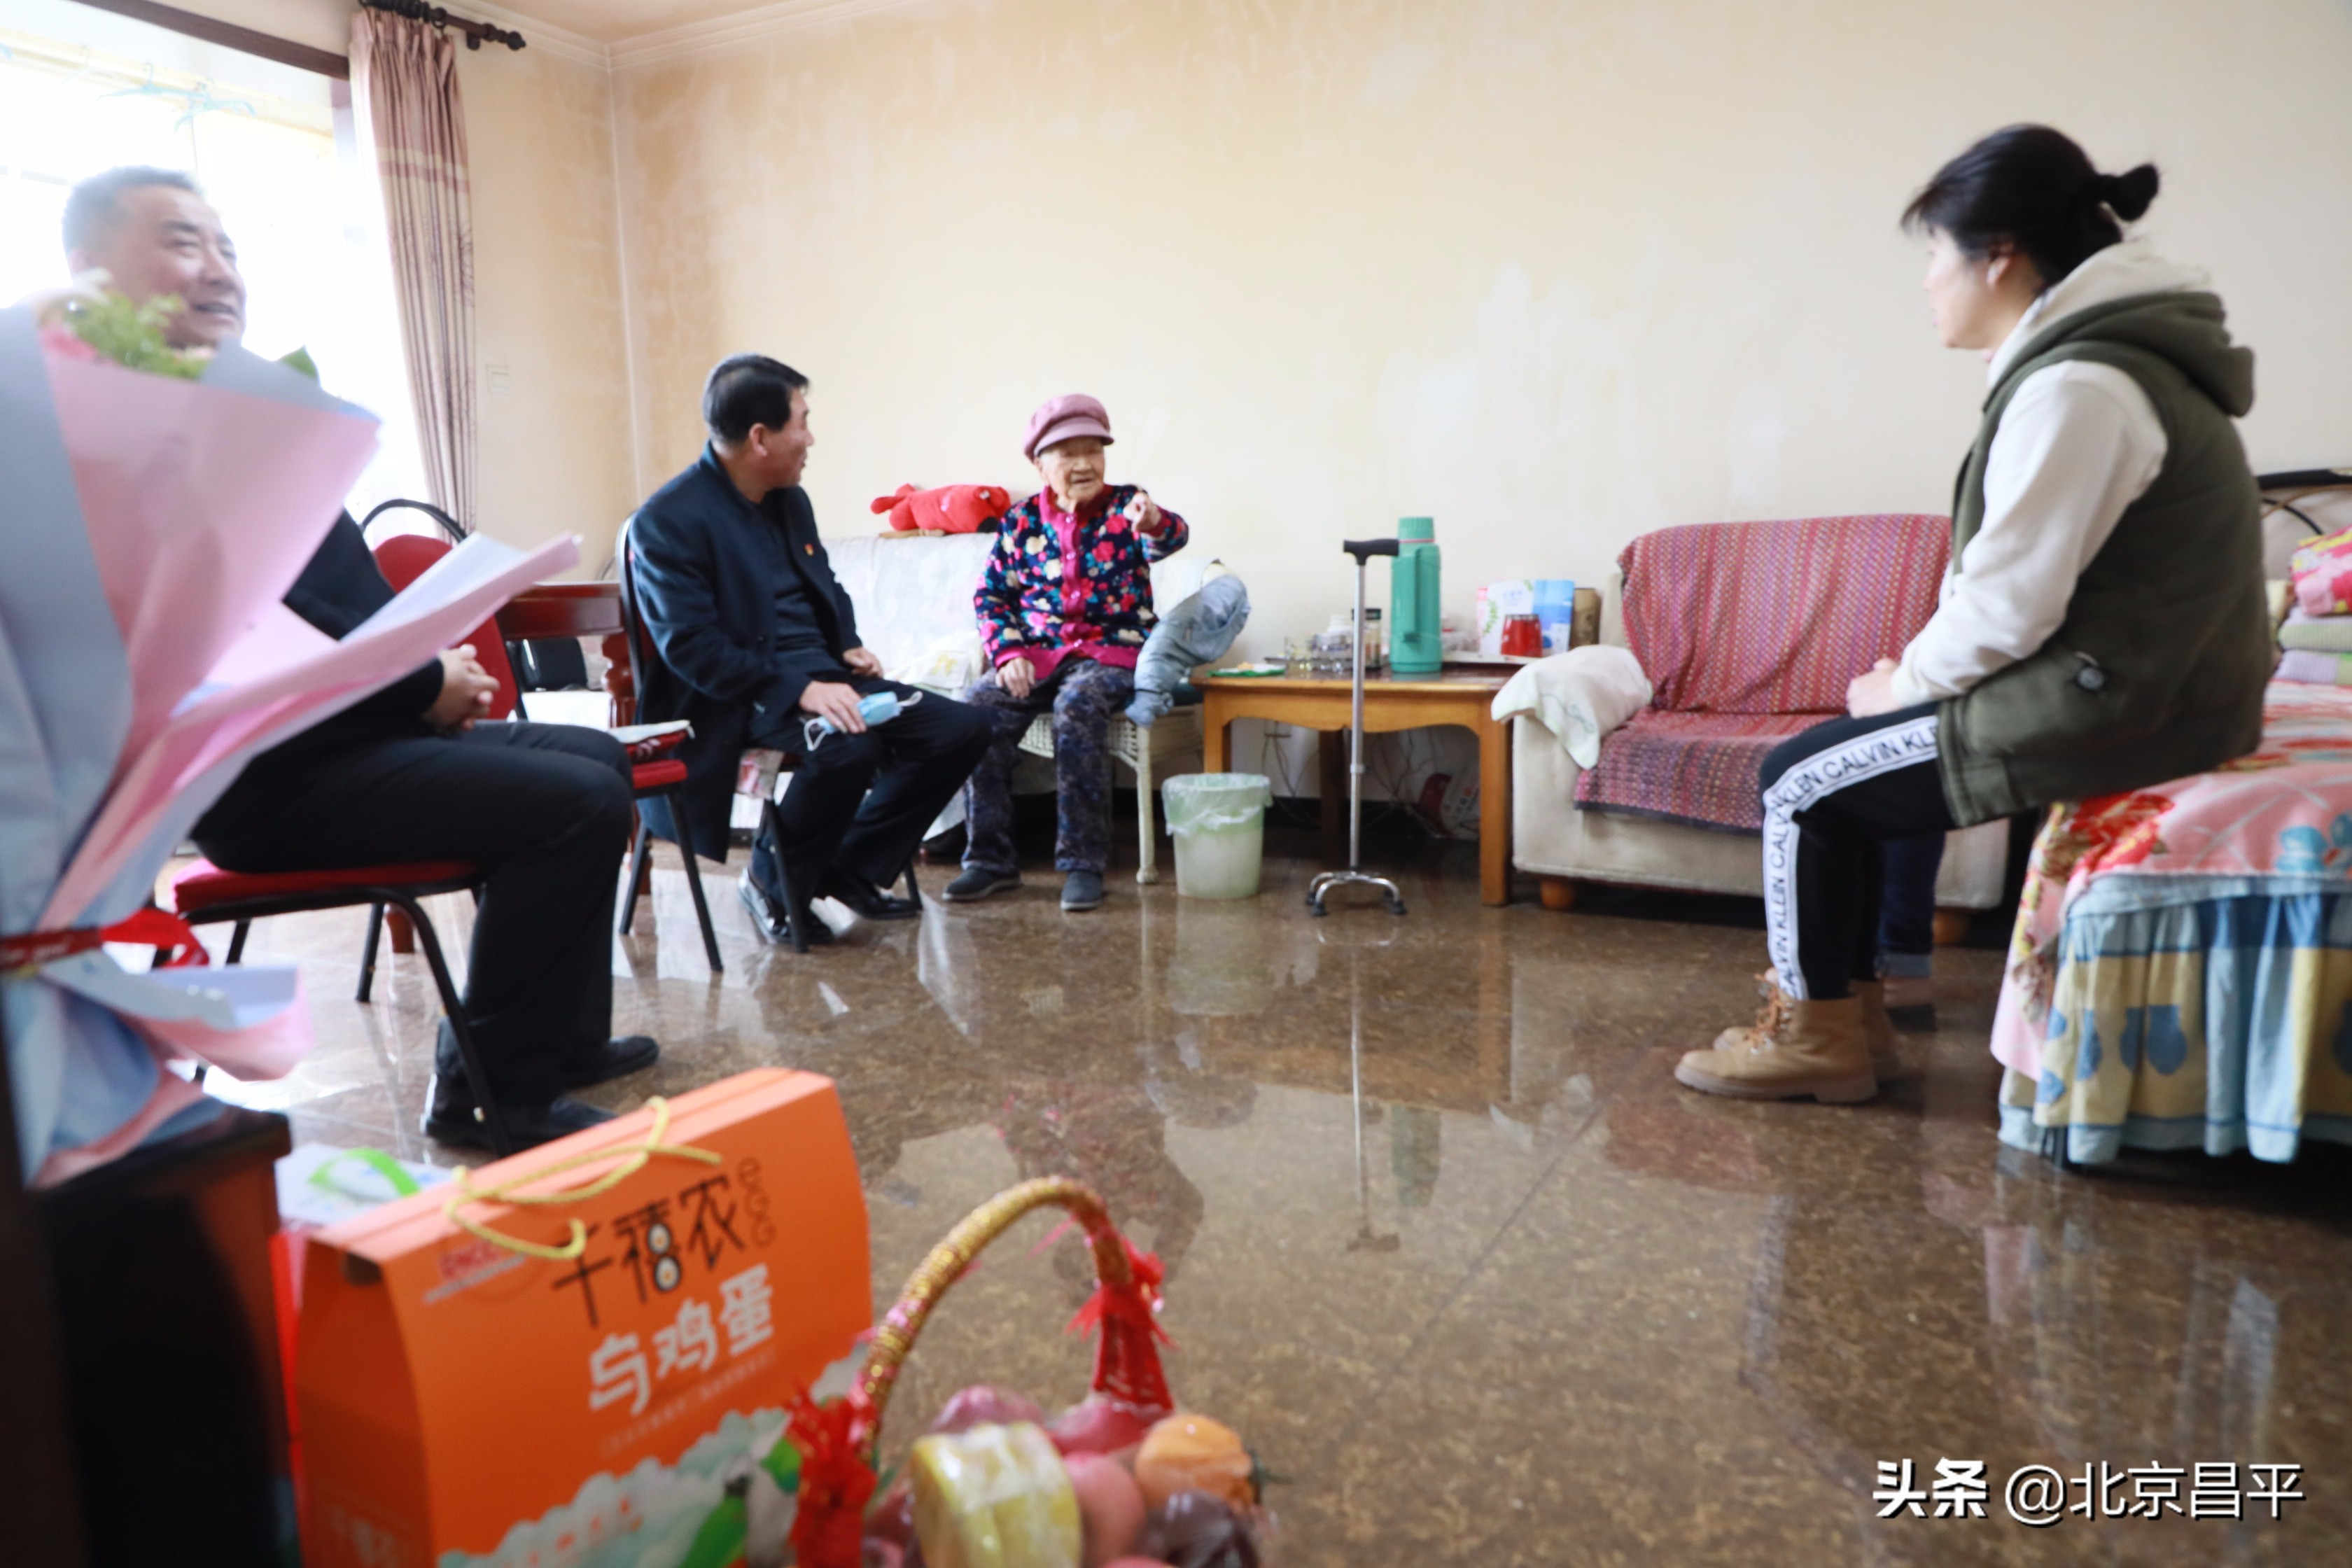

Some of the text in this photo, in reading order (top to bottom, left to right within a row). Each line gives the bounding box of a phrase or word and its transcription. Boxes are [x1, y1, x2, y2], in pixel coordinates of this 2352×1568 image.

[1823, 737, 1901, 779] CALVIN
[589, 1262, 774, 1418] 乌鸡蛋
